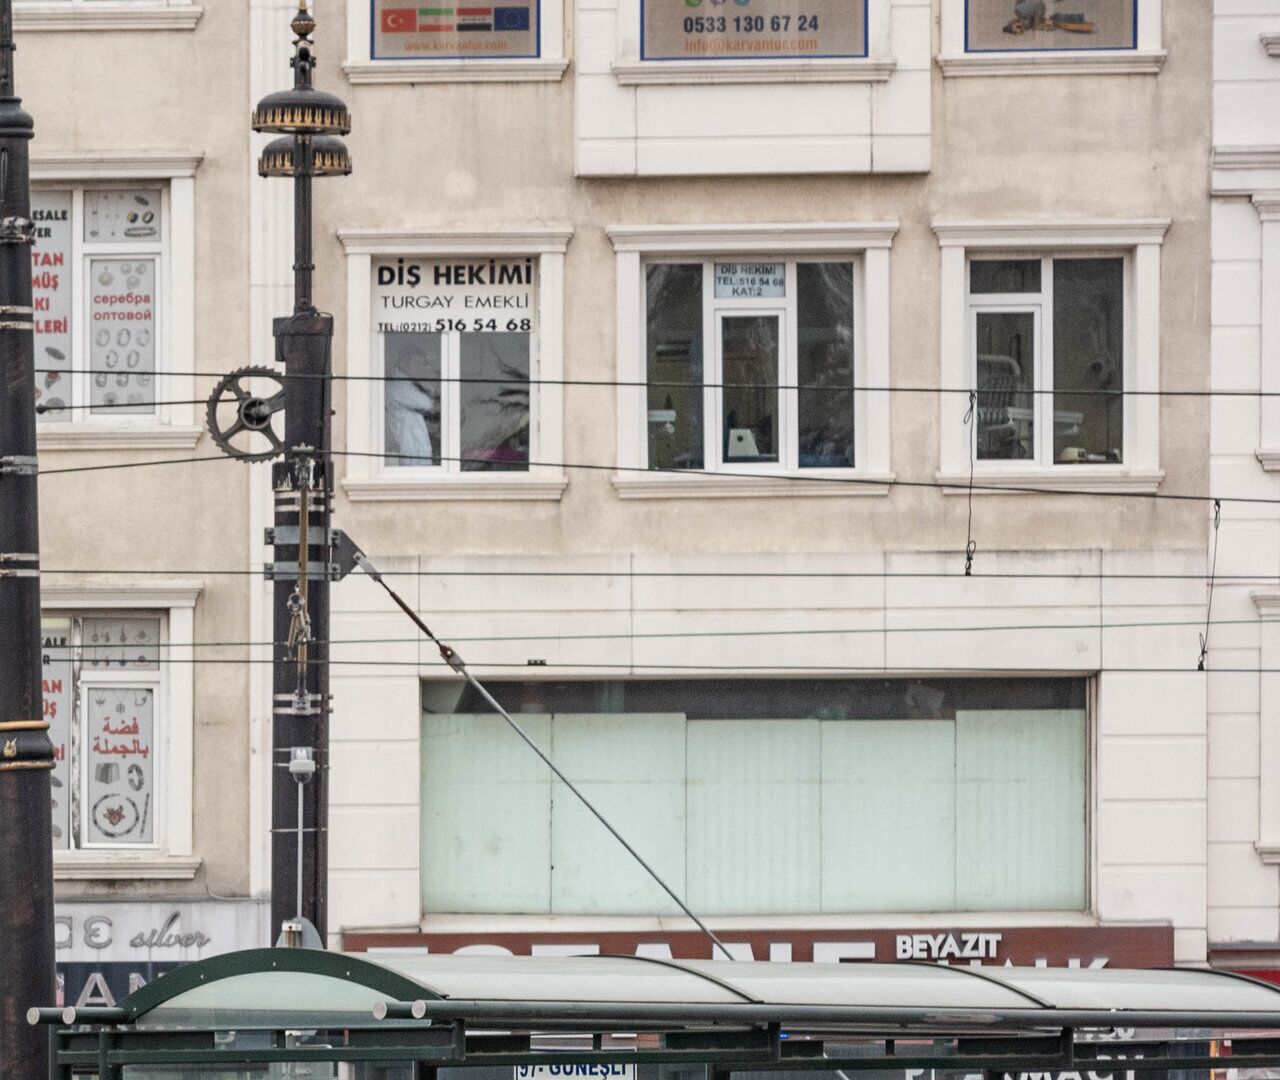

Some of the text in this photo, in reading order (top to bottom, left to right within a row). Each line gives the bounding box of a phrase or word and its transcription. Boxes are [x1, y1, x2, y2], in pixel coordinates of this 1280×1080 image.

[683, 15, 819, 33] 0533 130 67 24
[378, 258, 532, 288] DİŞ HEKİMİ
[381, 293, 529, 309] TURGAY EMEKLİ
[93, 309, 152, 321] оптовой
[435, 319, 466, 332] 516
[473, 319, 497, 331] 54
[506, 319, 531, 331] 68
[102, 717, 139, 735] فضة
[93, 740, 149, 758] بالجملة
[130, 911, 210, 948] silver
[896, 933, 1002, 960] BEYAZIT
